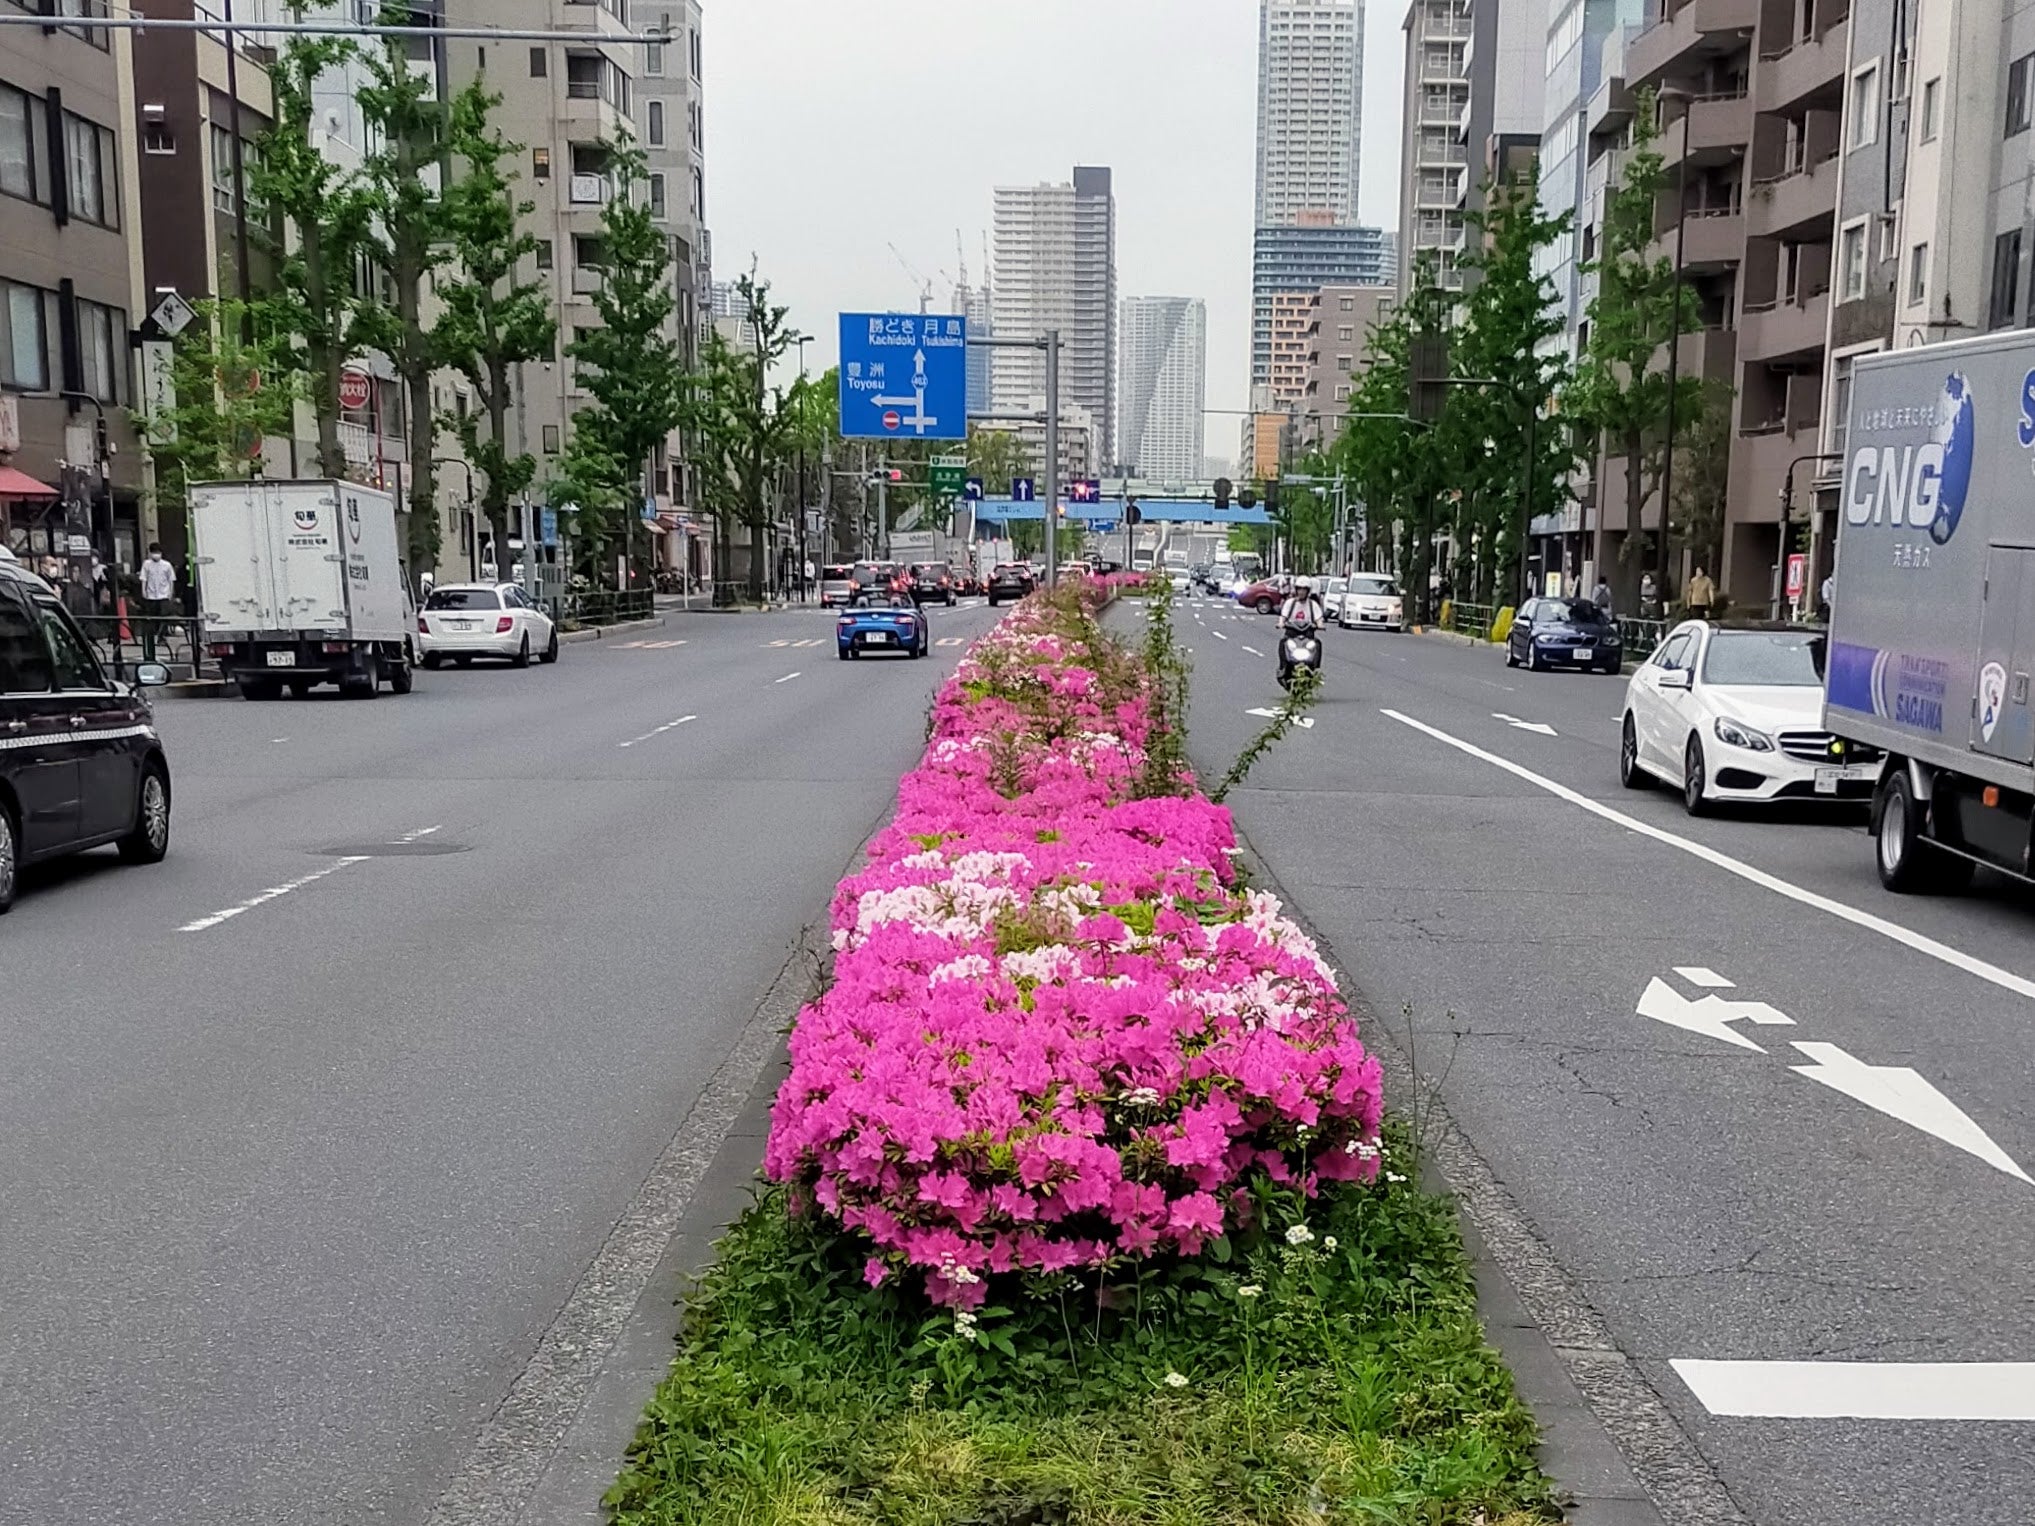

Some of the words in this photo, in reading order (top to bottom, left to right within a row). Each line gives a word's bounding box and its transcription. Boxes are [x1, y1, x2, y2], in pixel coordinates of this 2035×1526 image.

[869, 317, 914, 334] 勝どき
[924, 318, 961, 336] 月島
[869, 334, 916, 346] Kachidoki
[922, 335, 963, 347] Tsukishima
[847, 362, 885, 377] 豊洲
[847, 377, 885, 391] Toyosu
[1847, 442, 1944, 527] CNG
[1893, 544, 1931, 568] 天然ガス
[1896, 693, 1943, 733] SAGAWA
